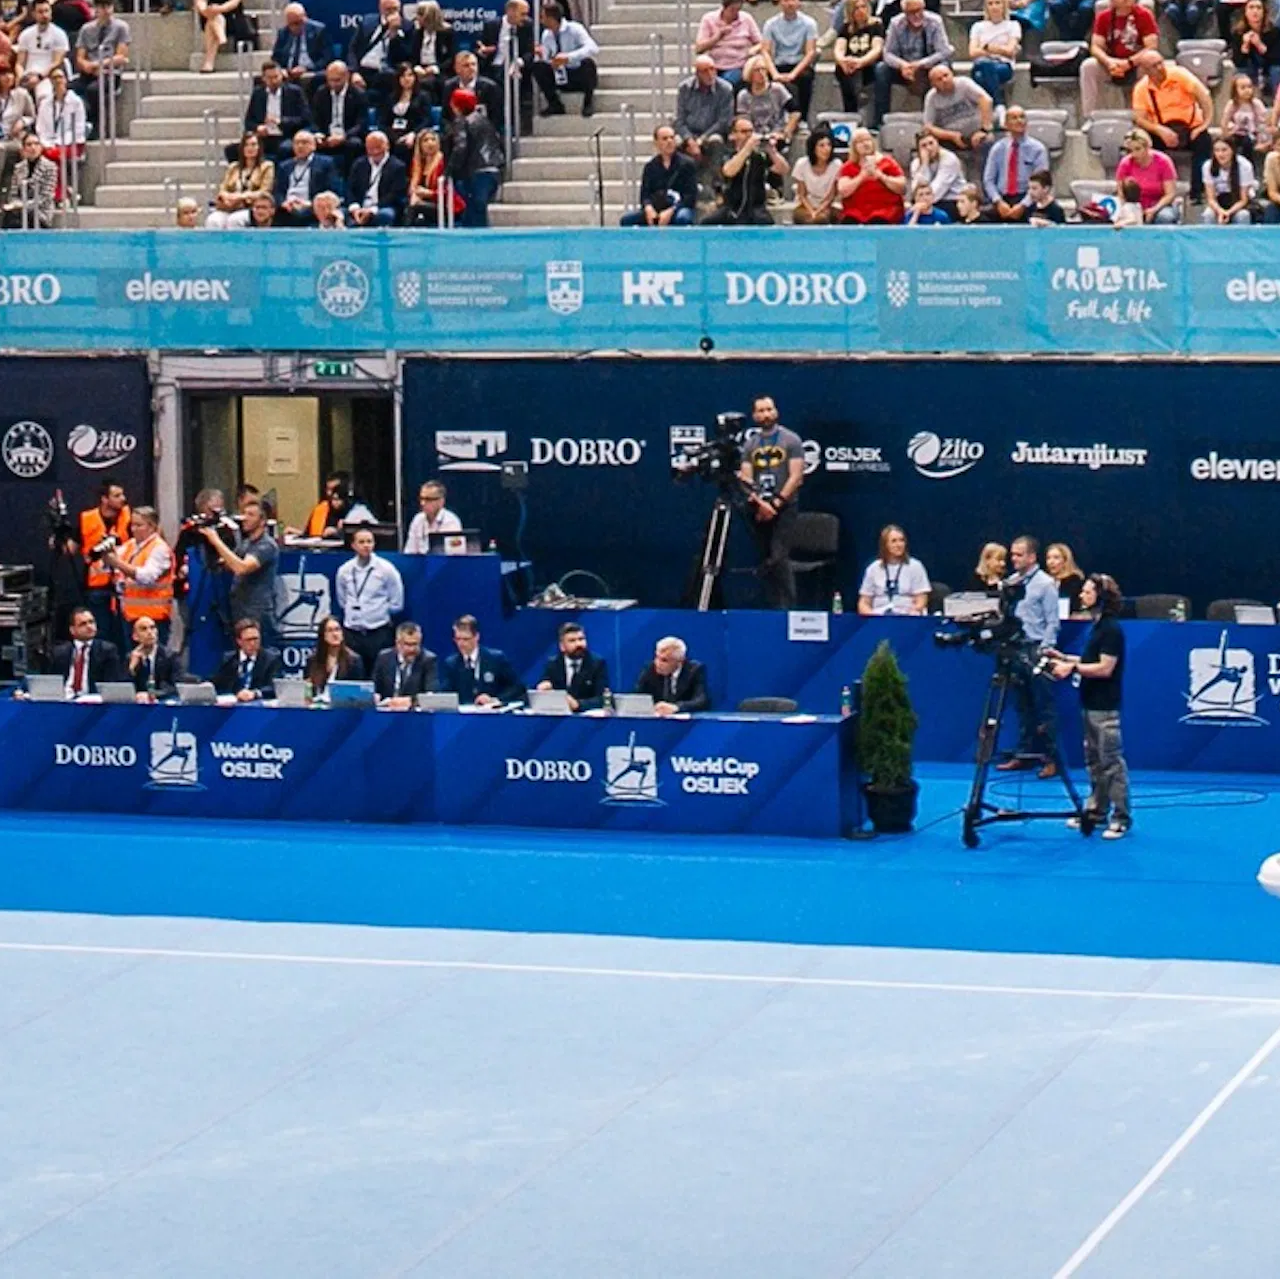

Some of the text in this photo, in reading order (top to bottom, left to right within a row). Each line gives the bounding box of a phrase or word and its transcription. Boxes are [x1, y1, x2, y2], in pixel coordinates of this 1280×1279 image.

[725, 271, 867, 306] DOBRO
[1051, 266, 1168, 293] CROATIA
[530, 438, 641, 465] DOBRO
[824, 447, 881, 462] OSIJEK
[55, 744, 137, 766] DOBRO
[210, 741, 294, 764] World Cup
[221, 761, 284, 779] OSIJEK
[505, 759, 592, 782] DOBRO
[671, 756, 760, 778] World Cup
[682, 777, 749, 795] OSIJEK
